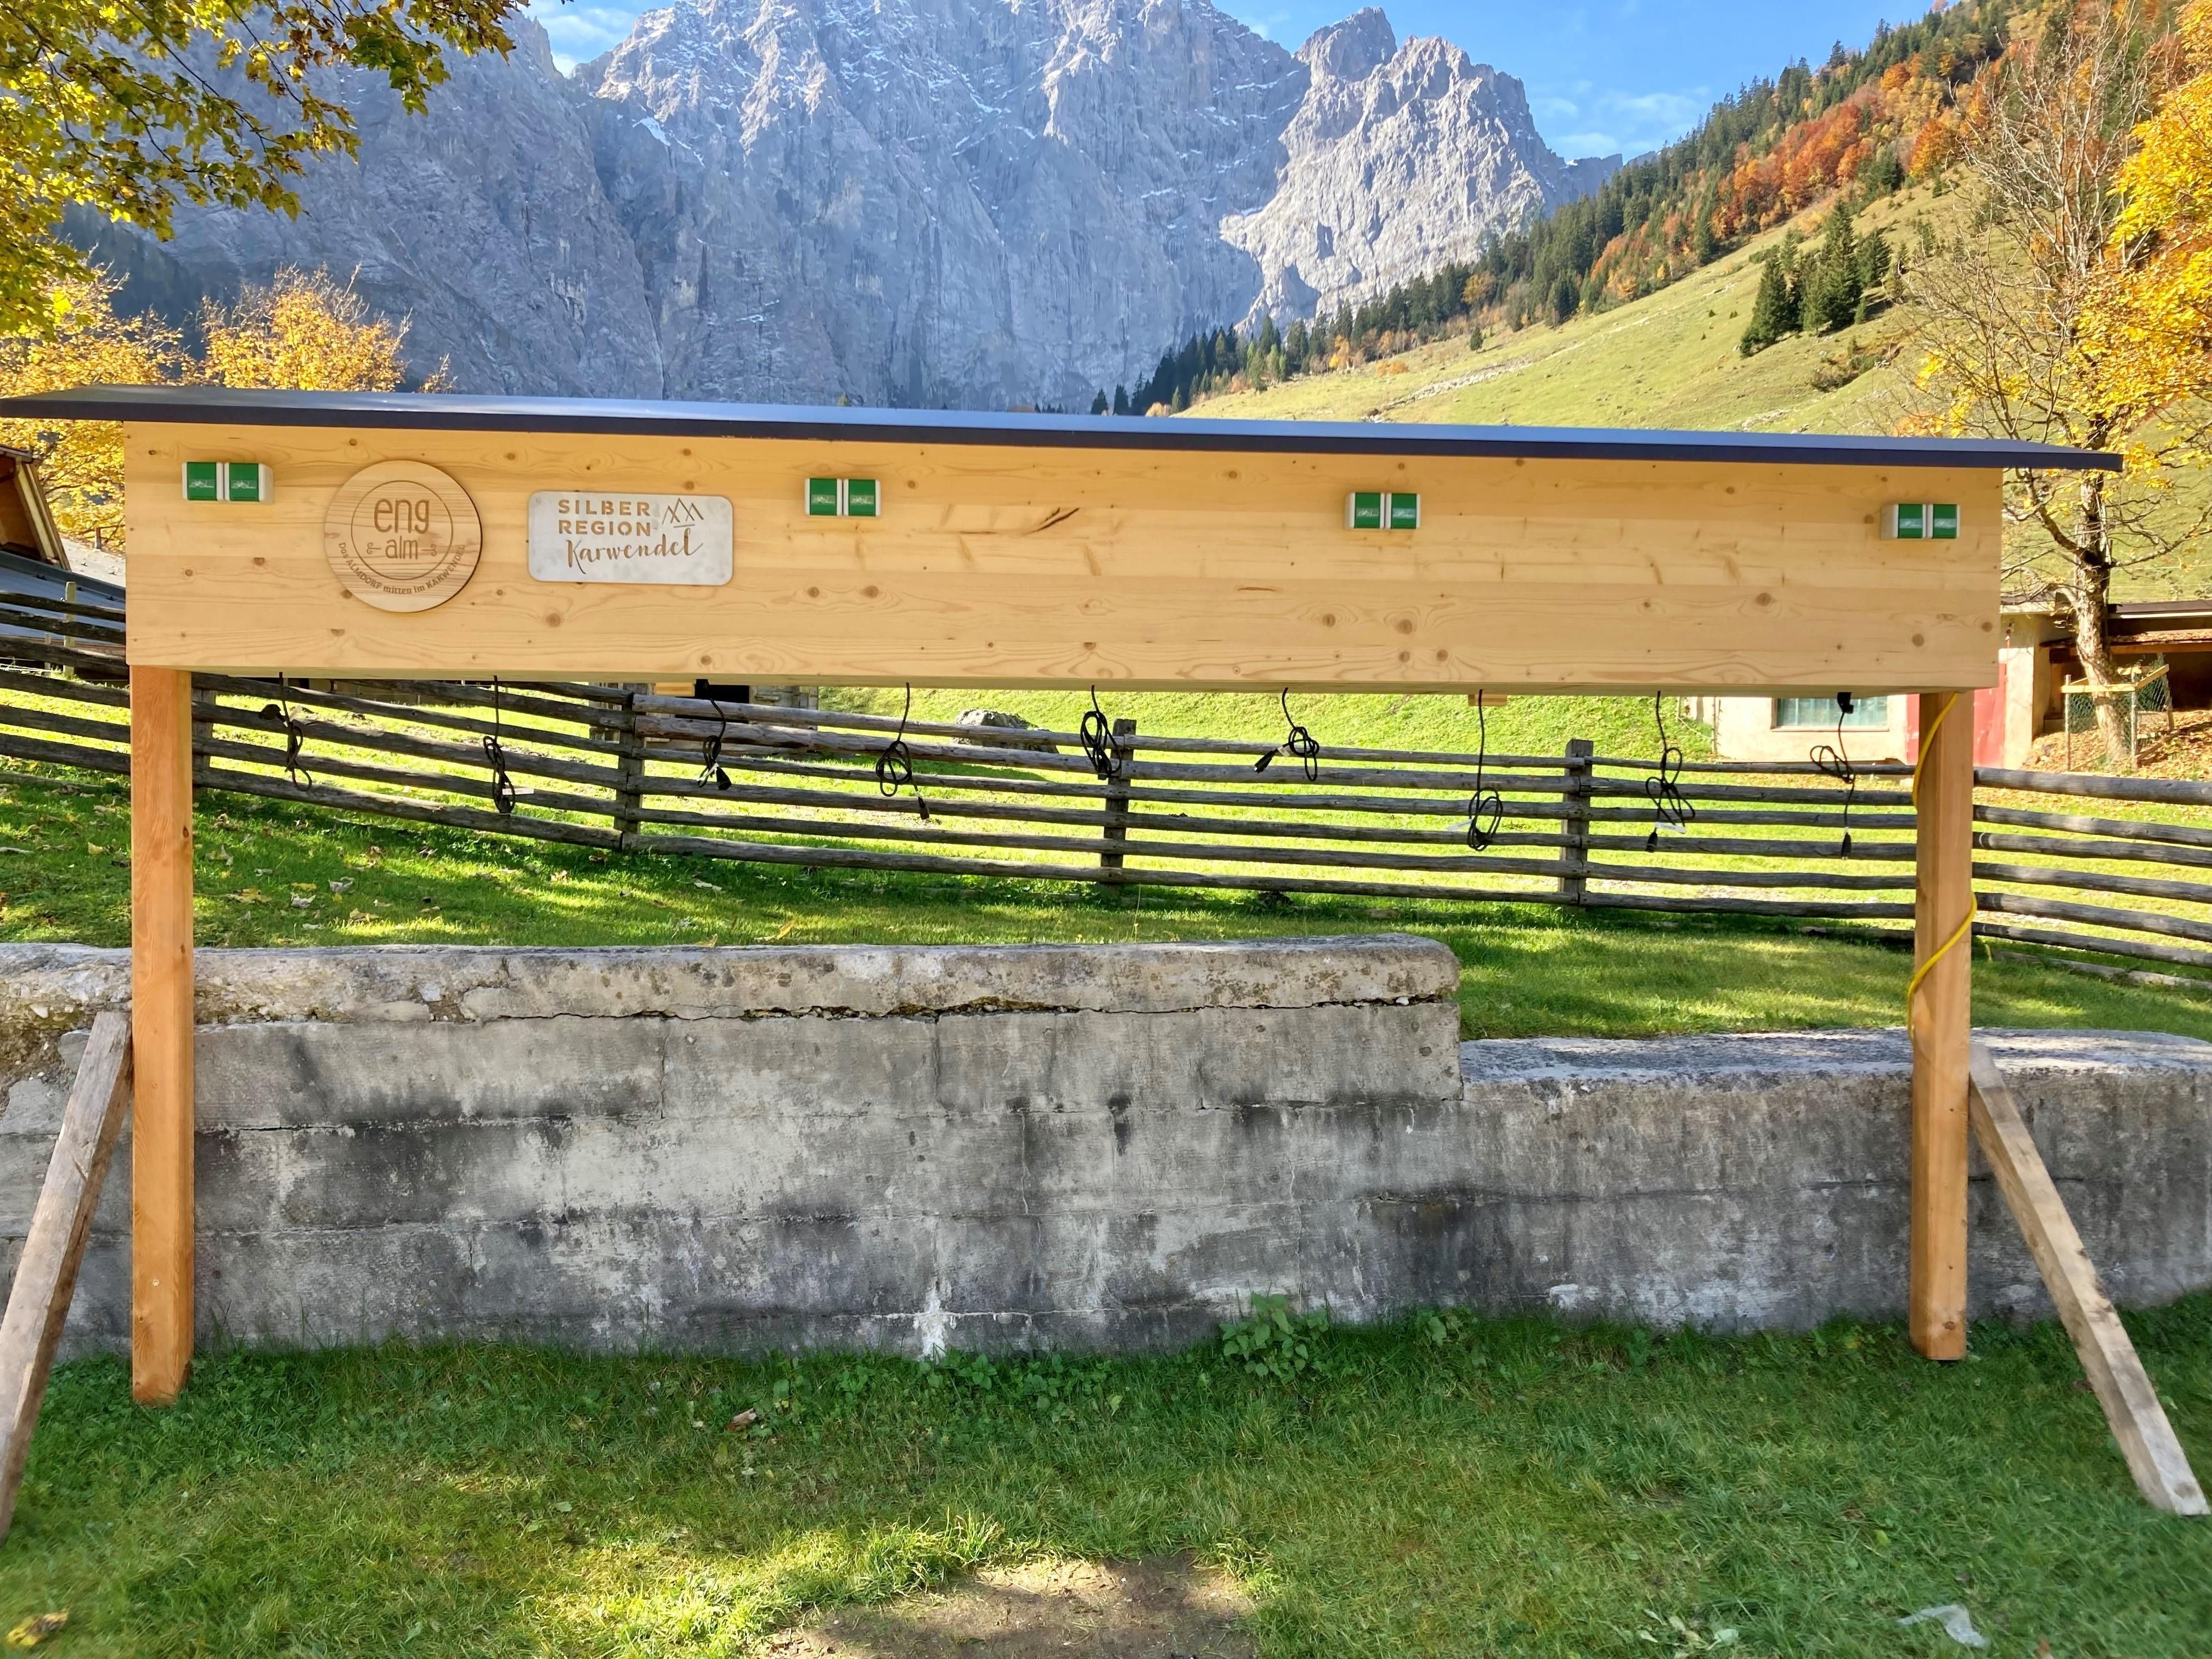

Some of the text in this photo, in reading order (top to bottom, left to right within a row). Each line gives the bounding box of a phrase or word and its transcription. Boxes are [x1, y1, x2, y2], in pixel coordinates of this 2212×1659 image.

[374, 498, 430, 534] eng
[558, 499, 651, 517] SILBER
[558, 520, 651, 537] REGION
[385, 535, 418, 560] alm
[566, 527, 704, 574] Karwendel
[338, 542, 349, 558] Das
[346, 559, 382, 589] ALMDORF
[383, 585, 412, 595] mitten
[426, 544, 465, 589] KARWENDEL
